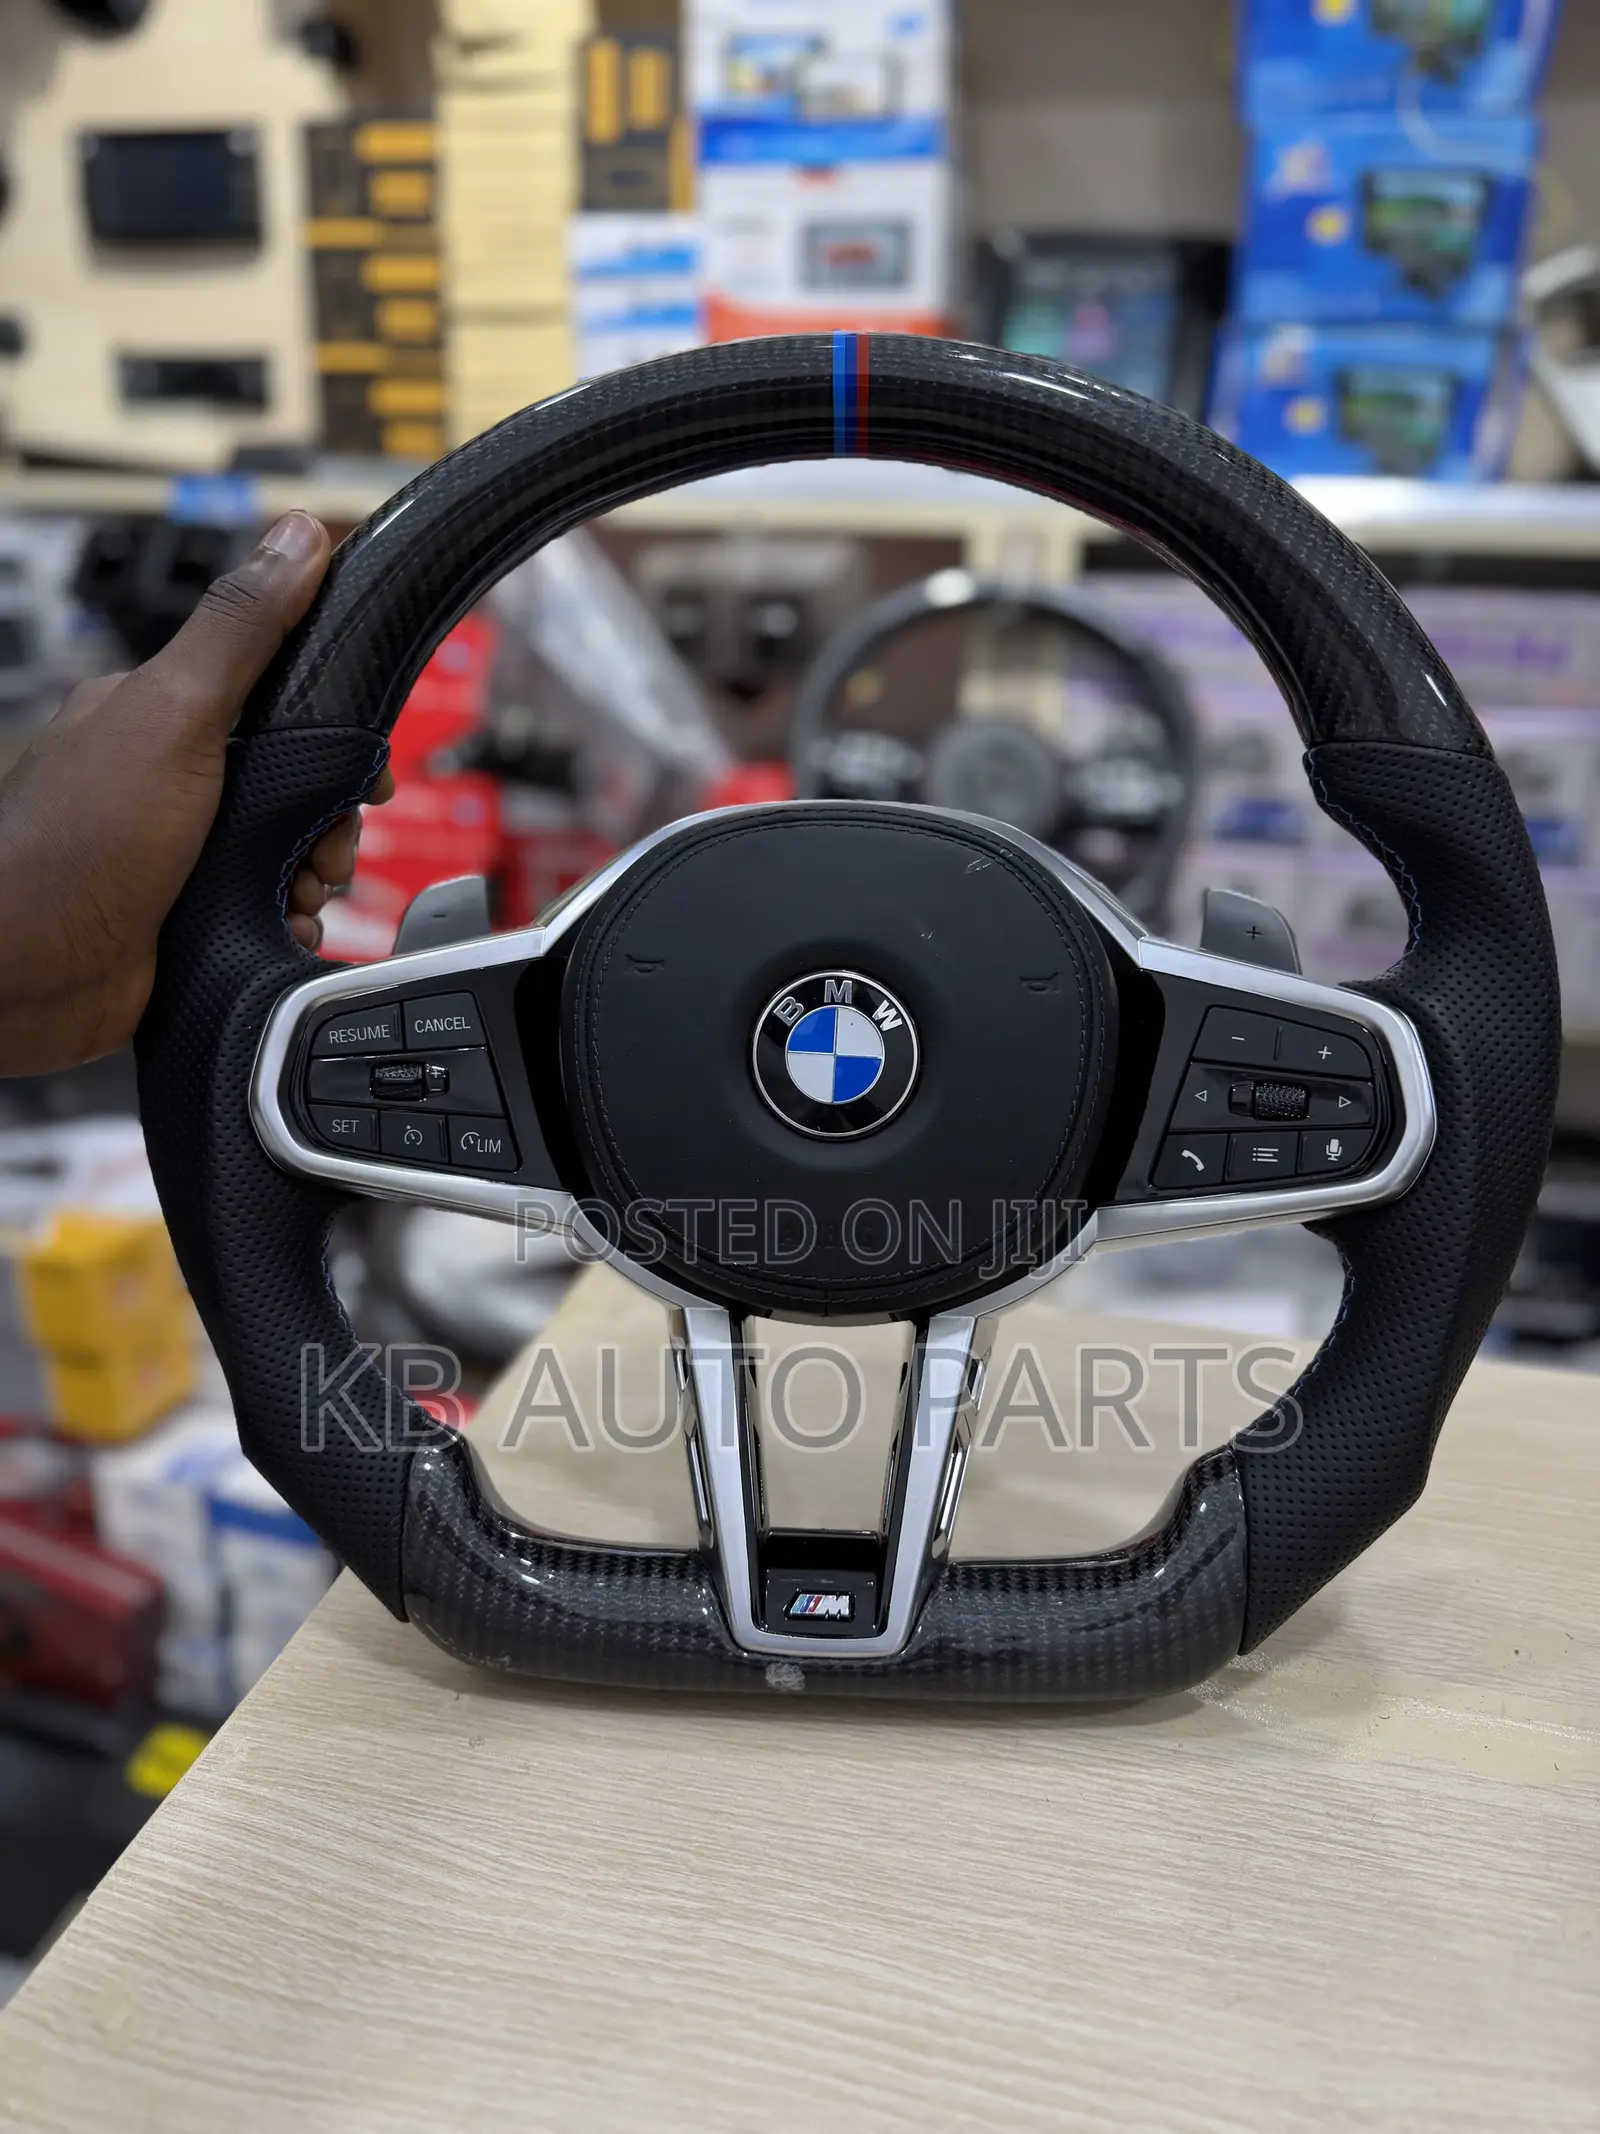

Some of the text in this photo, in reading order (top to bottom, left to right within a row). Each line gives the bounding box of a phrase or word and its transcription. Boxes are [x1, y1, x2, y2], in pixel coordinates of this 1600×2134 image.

[773, 979, 903, 1032] BMW
[329, 1024, 391, 1044] RESUME
[414, 1016, 471, 1034] CANCEL
[331, 1119, 359, 1133] SET
[476, 1138, 501, 1153] LIM
